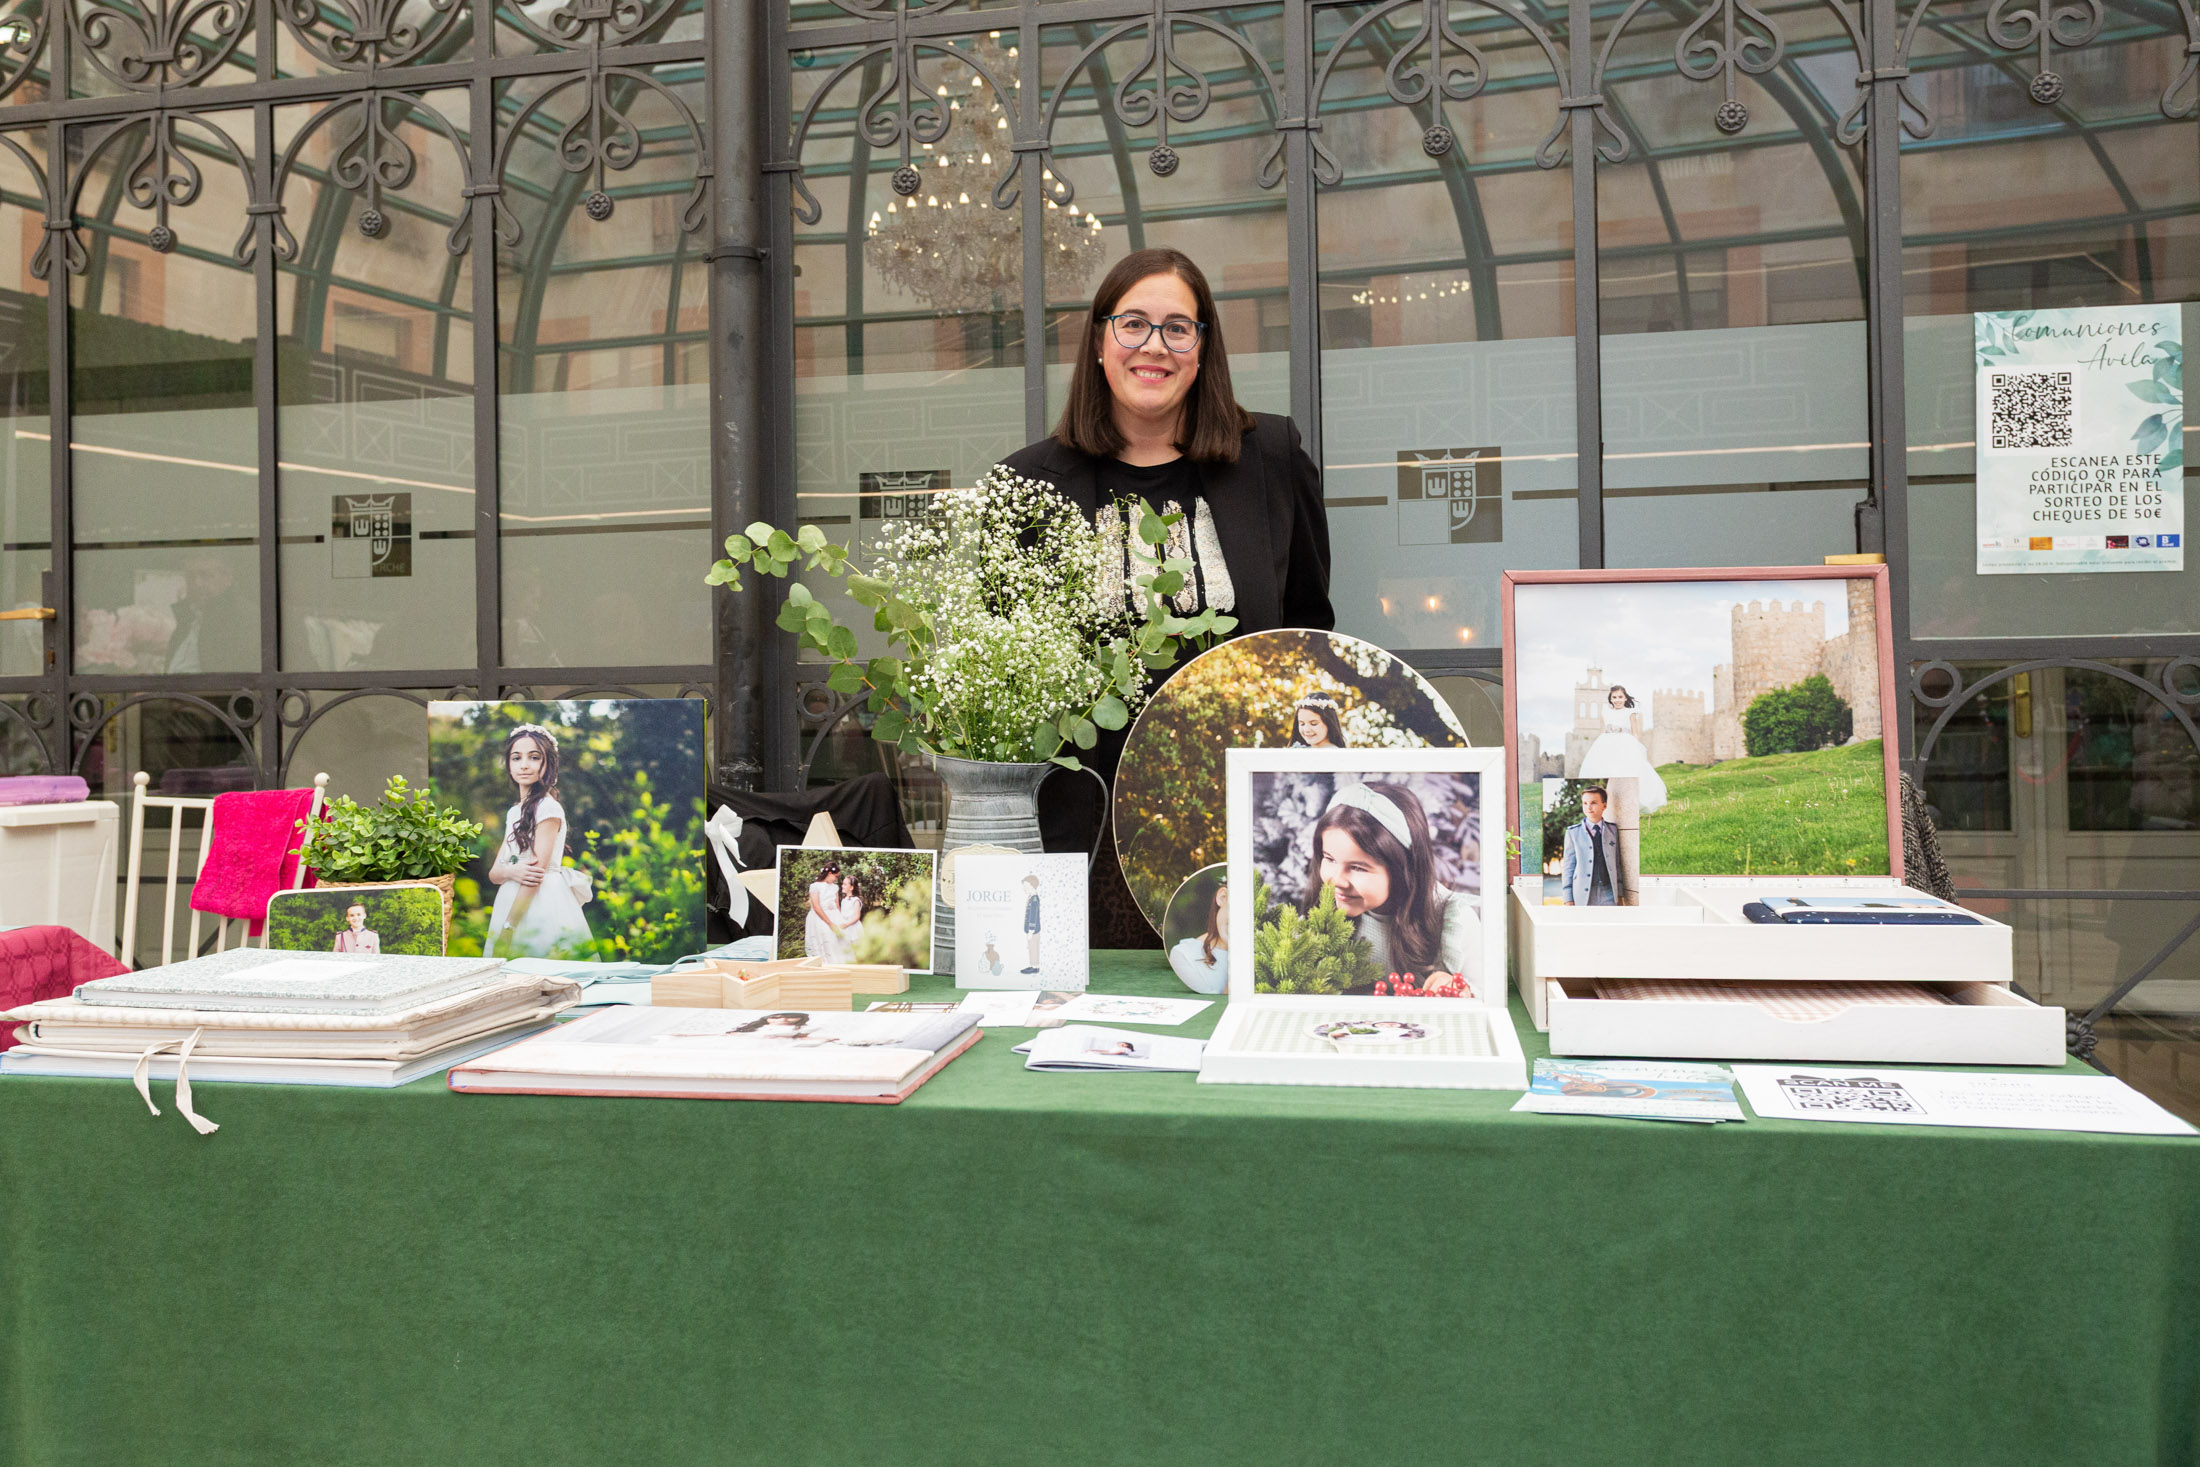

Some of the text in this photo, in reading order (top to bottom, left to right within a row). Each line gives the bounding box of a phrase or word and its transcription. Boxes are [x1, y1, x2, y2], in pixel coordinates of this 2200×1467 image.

[2011, 315, 2167, 341] Comuniones
[2077, 337, 2158, 371] Ávila
[2051, 454, 2162, 468] ESCANEA ESTE
[2031, 468, 2162, 483] CÓDIGO QR PARA
[2029, 481, 2162, 494] PARTICIPAR EN EL
[2044, 494, 2162, 508] SORTEO DE LOS
[2033, 508, 2162, 524] CHEQUES DE 50€
[966, 890, 1012, 902] JORGE
[1783, 1079, 1897, 1089] SCAN ME
